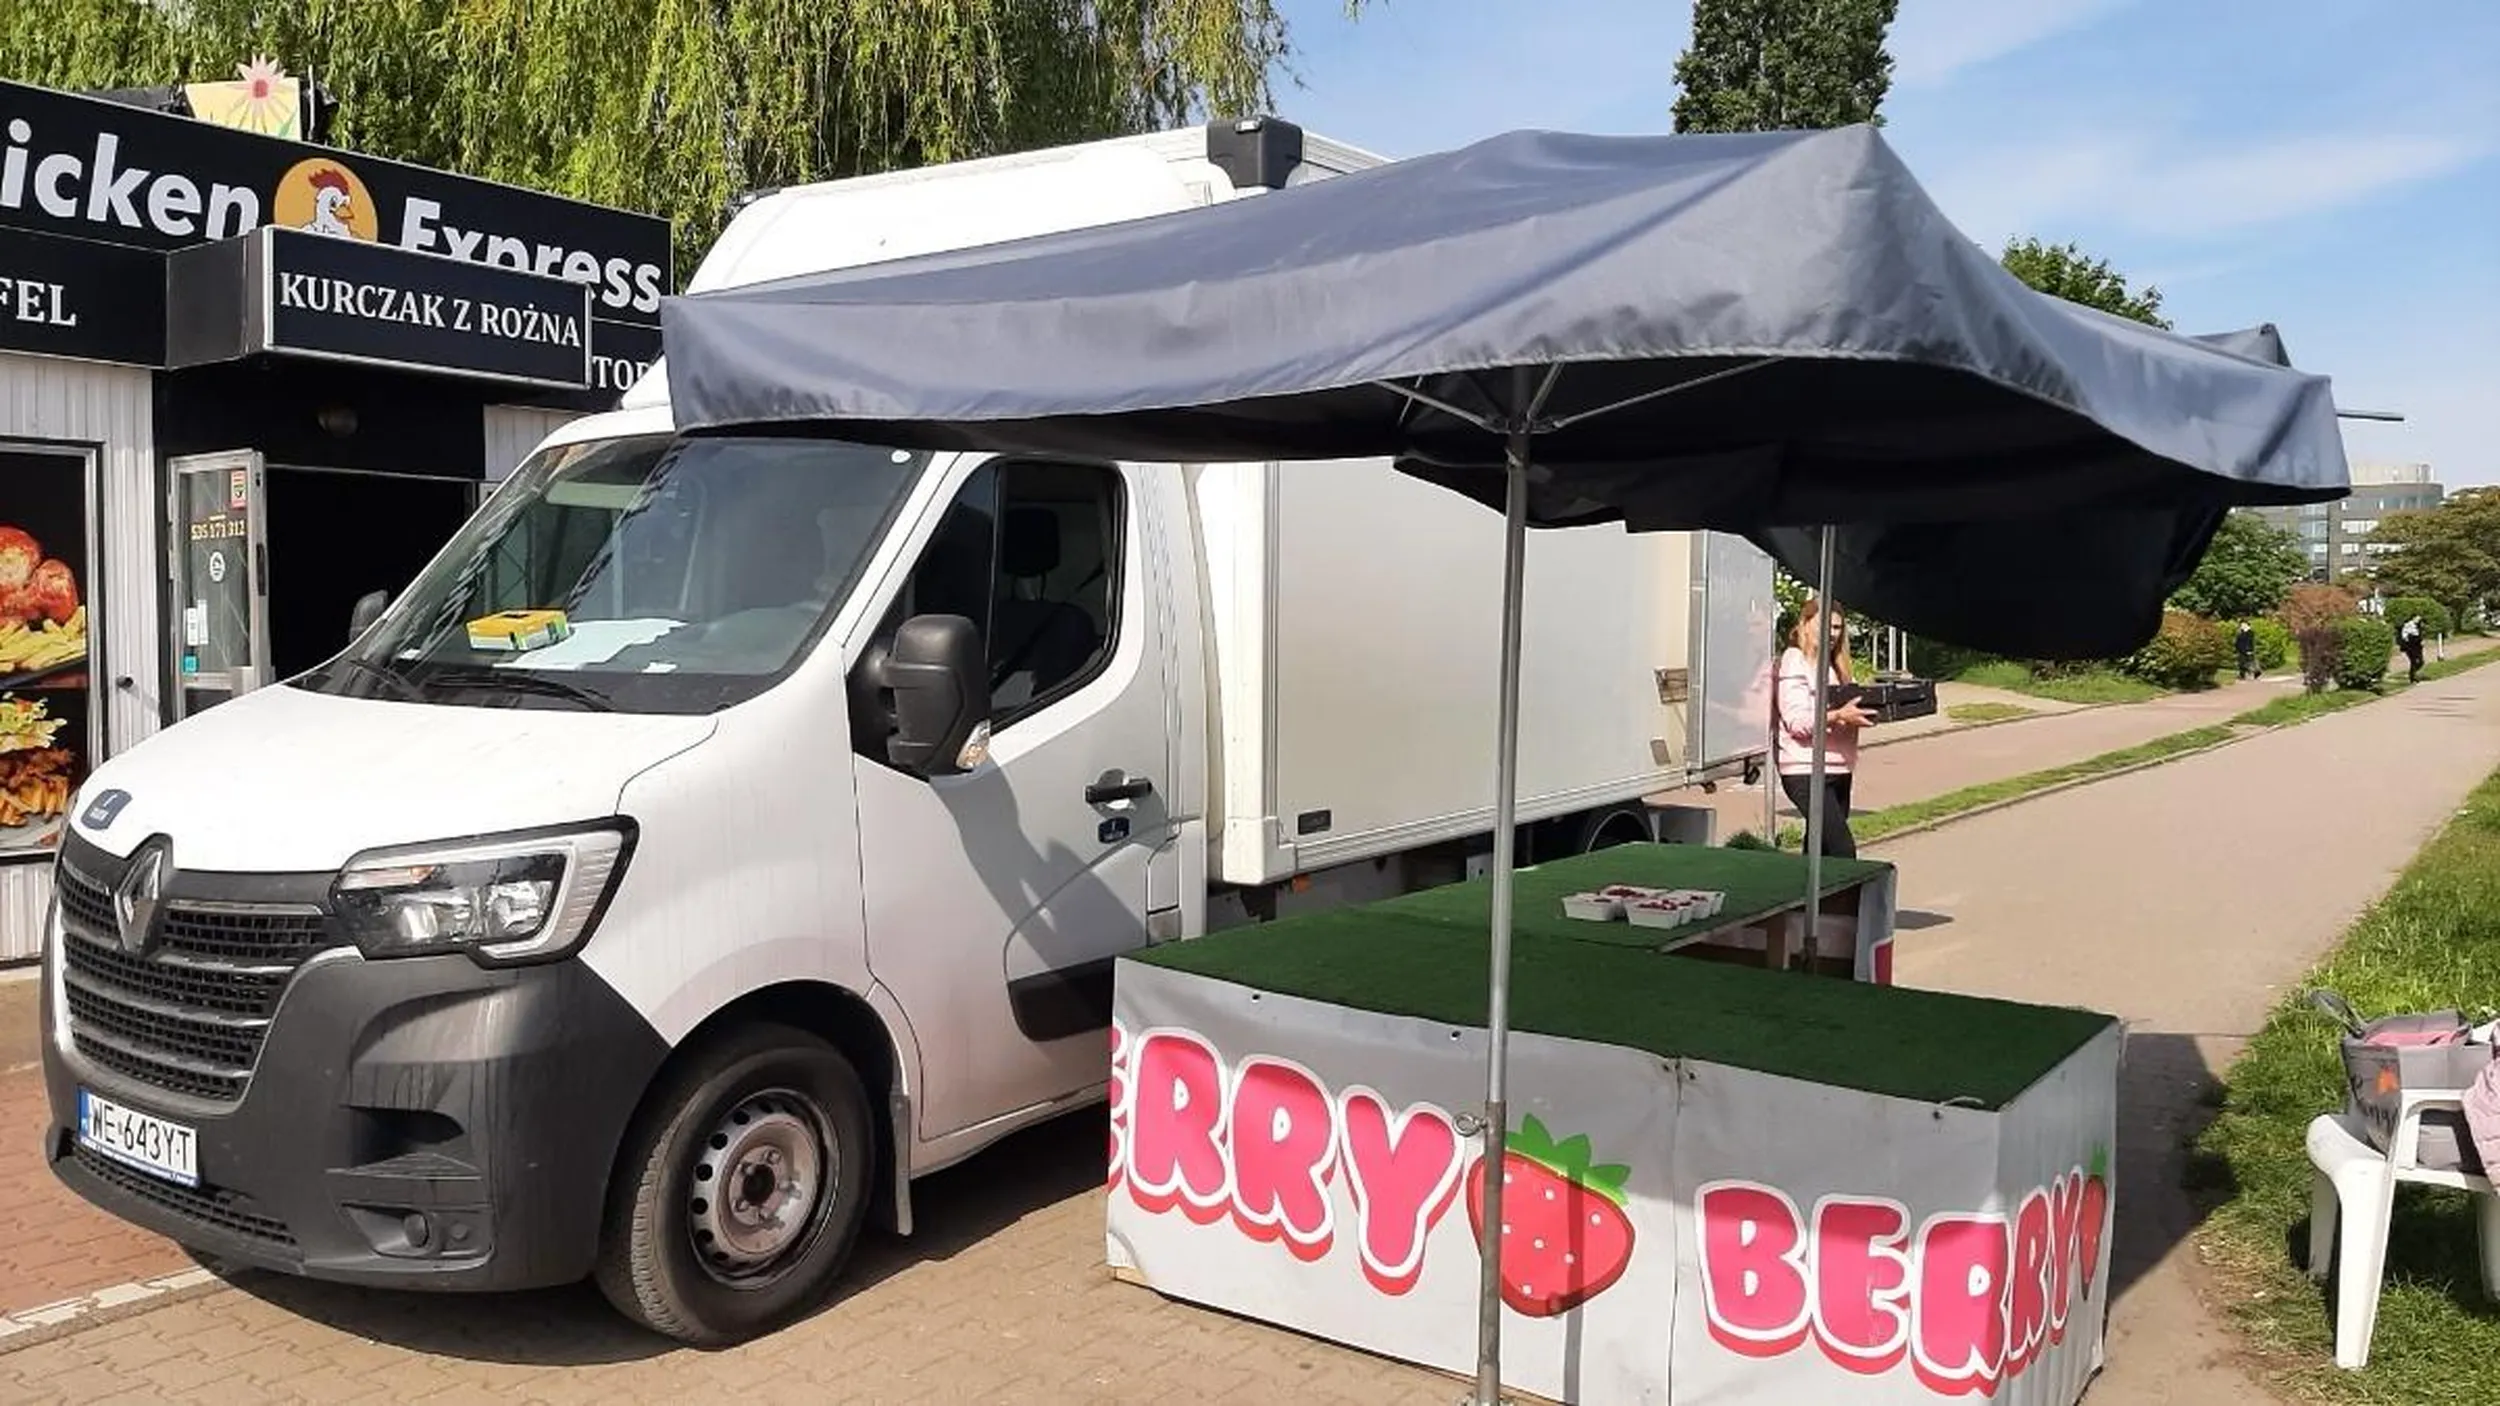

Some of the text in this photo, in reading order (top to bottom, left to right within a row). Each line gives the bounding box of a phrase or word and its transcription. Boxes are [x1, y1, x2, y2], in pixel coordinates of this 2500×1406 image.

[280, 271, 581, 348] KURCZAK Z ROŻNA
[1696, 1166, 2084, 1398] BERRY
